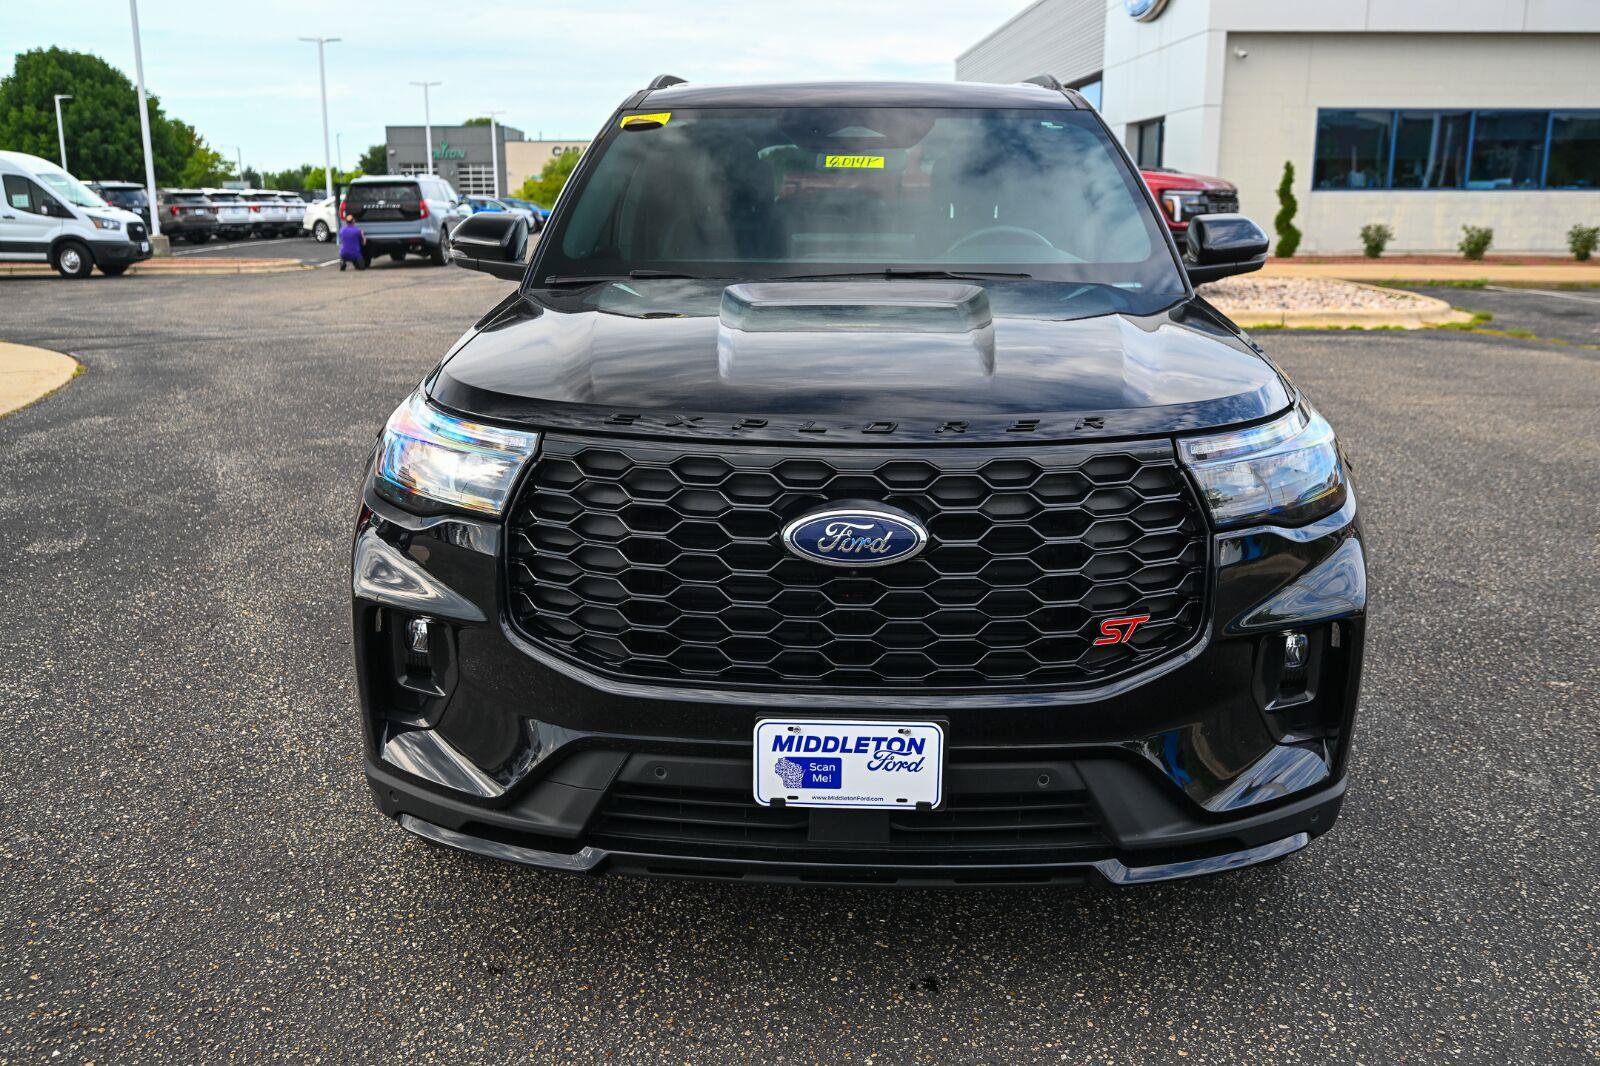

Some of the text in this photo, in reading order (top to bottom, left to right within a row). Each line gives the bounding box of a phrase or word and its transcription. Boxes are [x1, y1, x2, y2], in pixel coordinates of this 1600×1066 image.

[603, 413, 1105, 435] EXPLORER
[817, 521, 894, 553] Ford
[1093, 615, 1150, 646] ST
[771, 735, 926, 755] MIDDLETON
[809, 762, 836, 772] Scan
[867, 750, 926, 773] Ford
[812, 773, 832, 783] Me!
